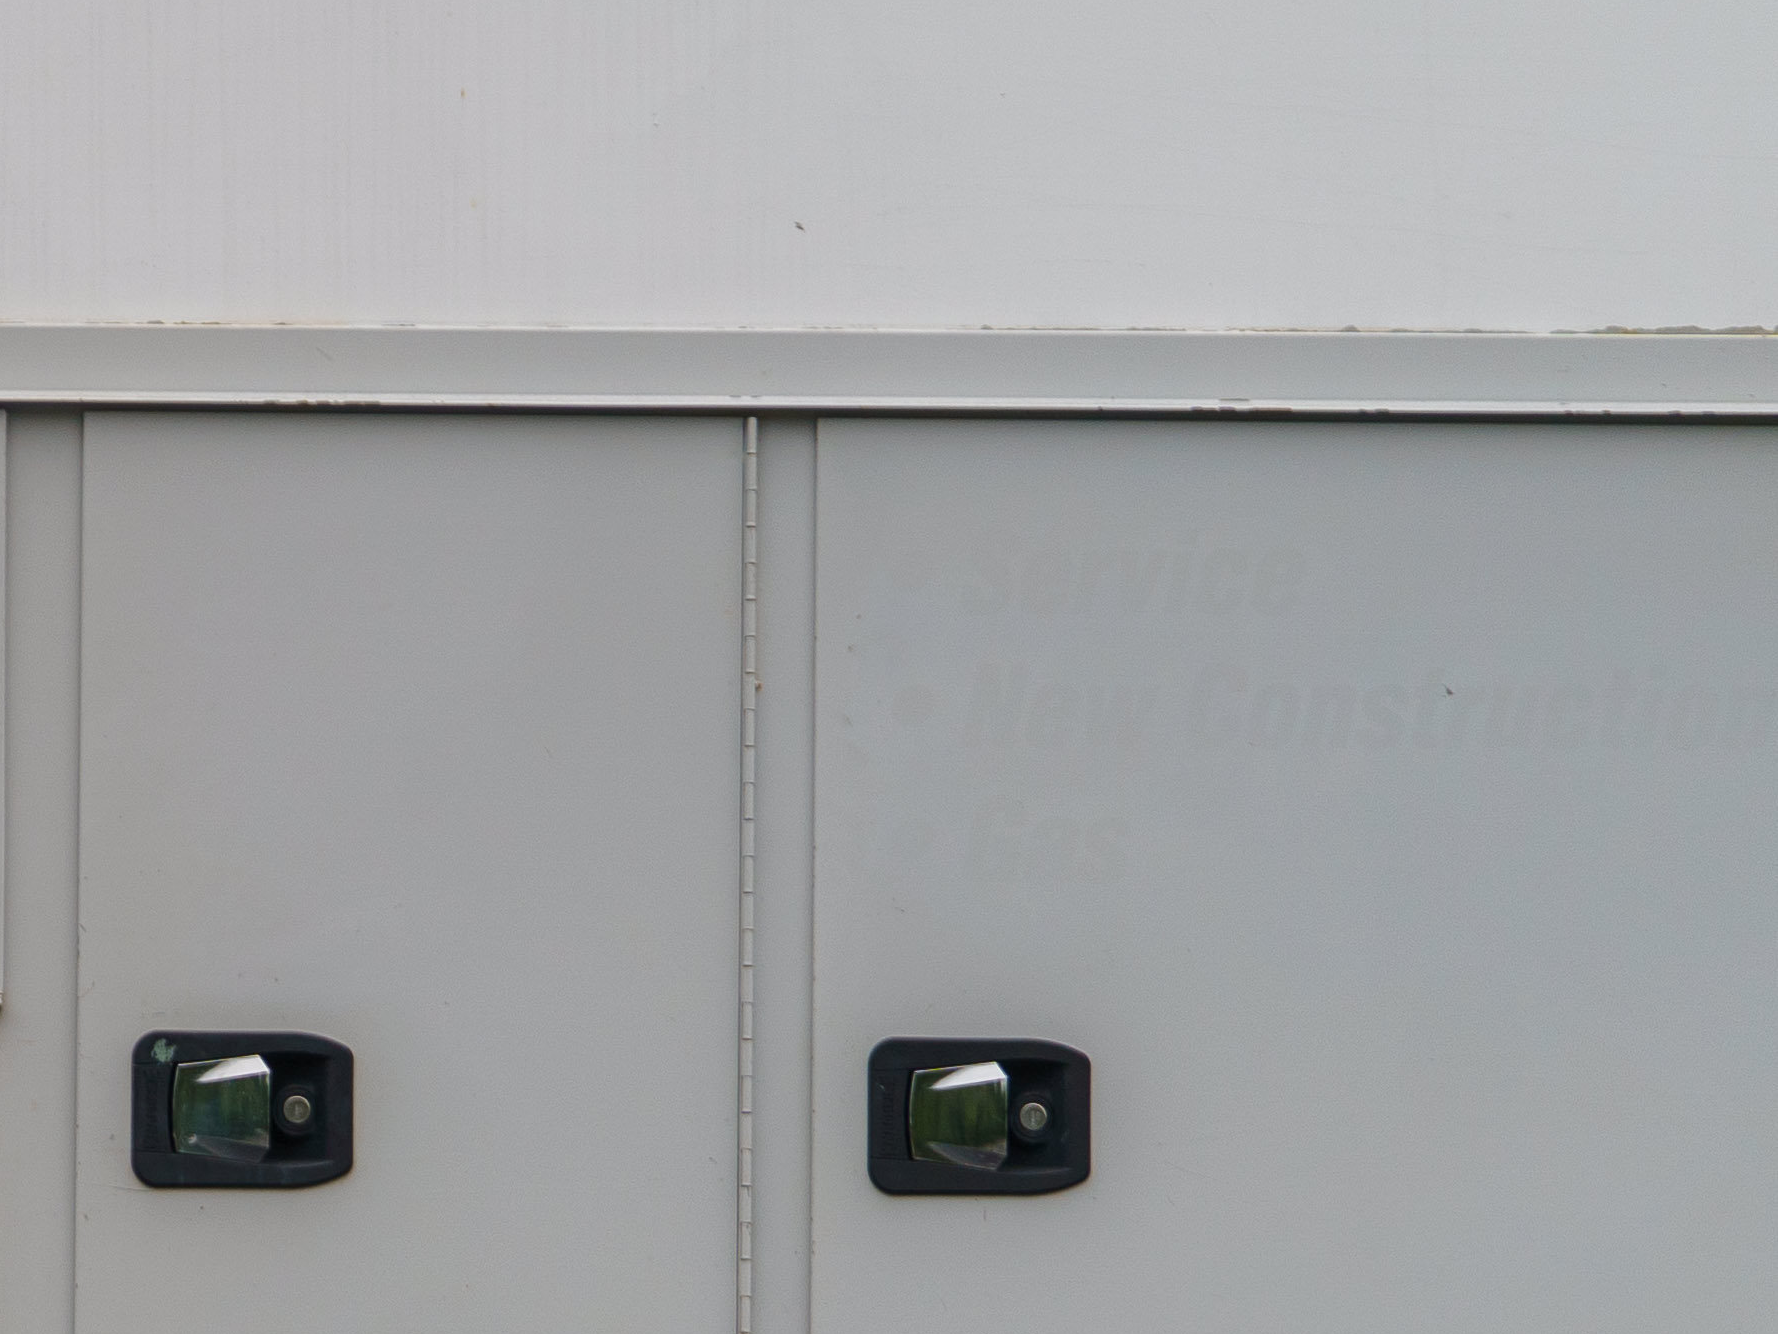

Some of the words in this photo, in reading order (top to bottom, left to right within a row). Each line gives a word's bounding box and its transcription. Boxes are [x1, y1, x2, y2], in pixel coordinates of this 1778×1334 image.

[961, 528, 1308, 618] Service
[961, 662, 1160, 751] New
[1185, 663, 1778, 751] Construction
[961, 795, 1133, 885] Gas
